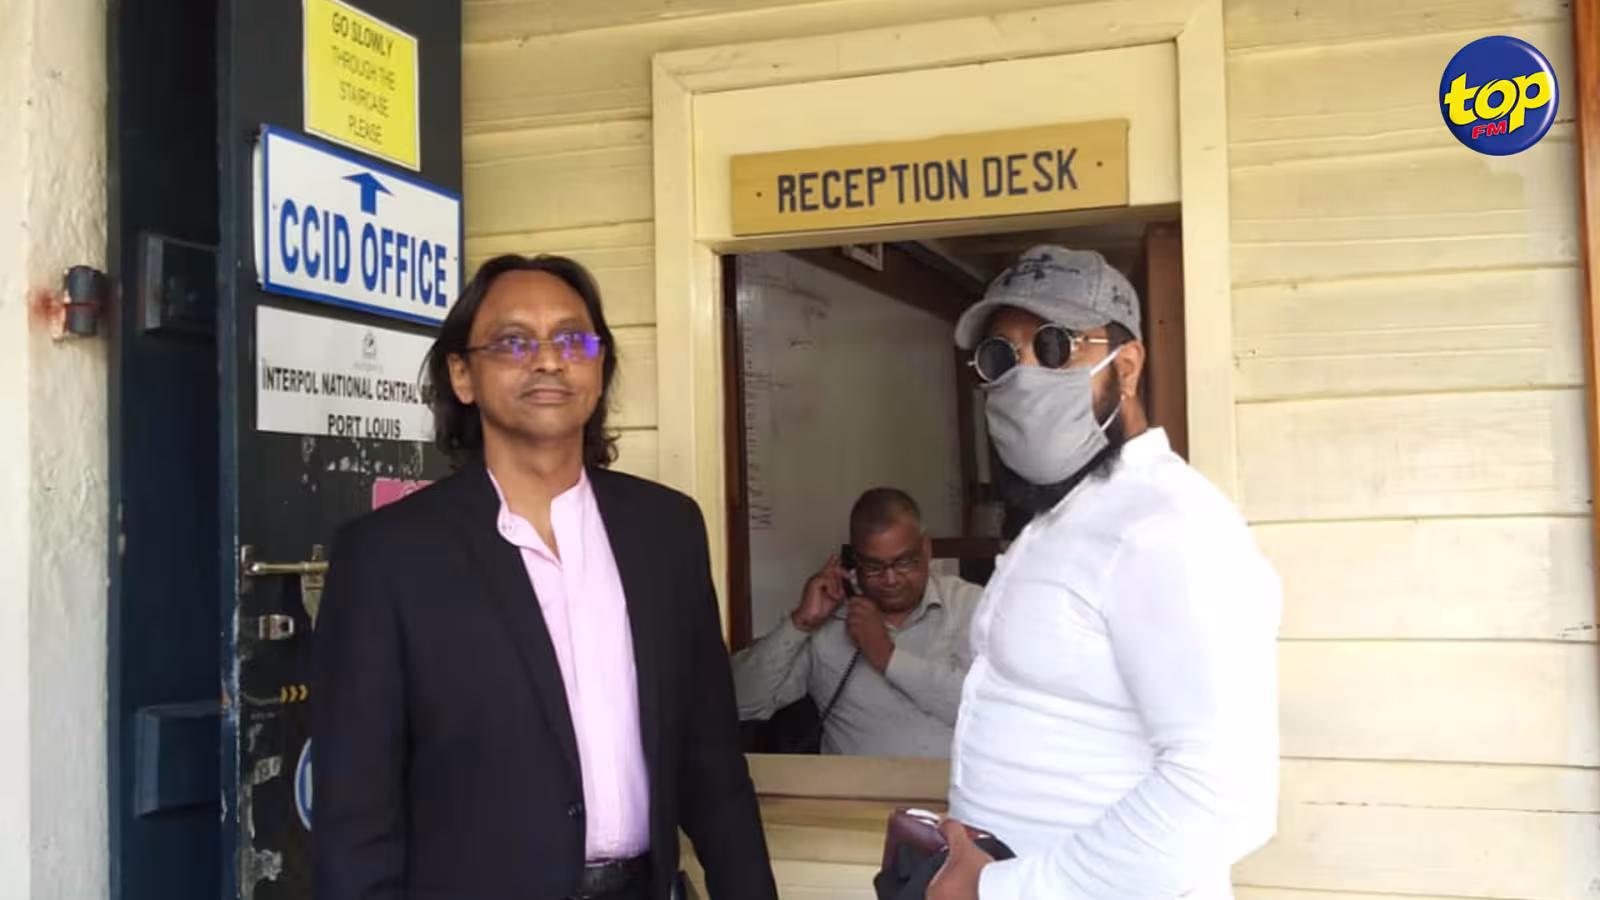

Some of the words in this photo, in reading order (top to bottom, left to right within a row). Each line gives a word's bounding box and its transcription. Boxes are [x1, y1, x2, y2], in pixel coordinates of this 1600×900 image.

[331, 11, 349, 38] GO
[351, 20, 395, 59] SLOWLY
[777, 158, 969, 213] RECEPTION
[983, 147, 1078, 199] DESK
[279, 197, 350, 285] CCID
[360, 221, 448, 309] OFFICE
[262, 366, 319, 395] INTERPOL
[322, 372, 373, 401] NATIONAL
[375, 379, 418, 405] CENTRAL
[327, 413, 362, 438] PORT
[365, 420, 401, 439] LOUIS
